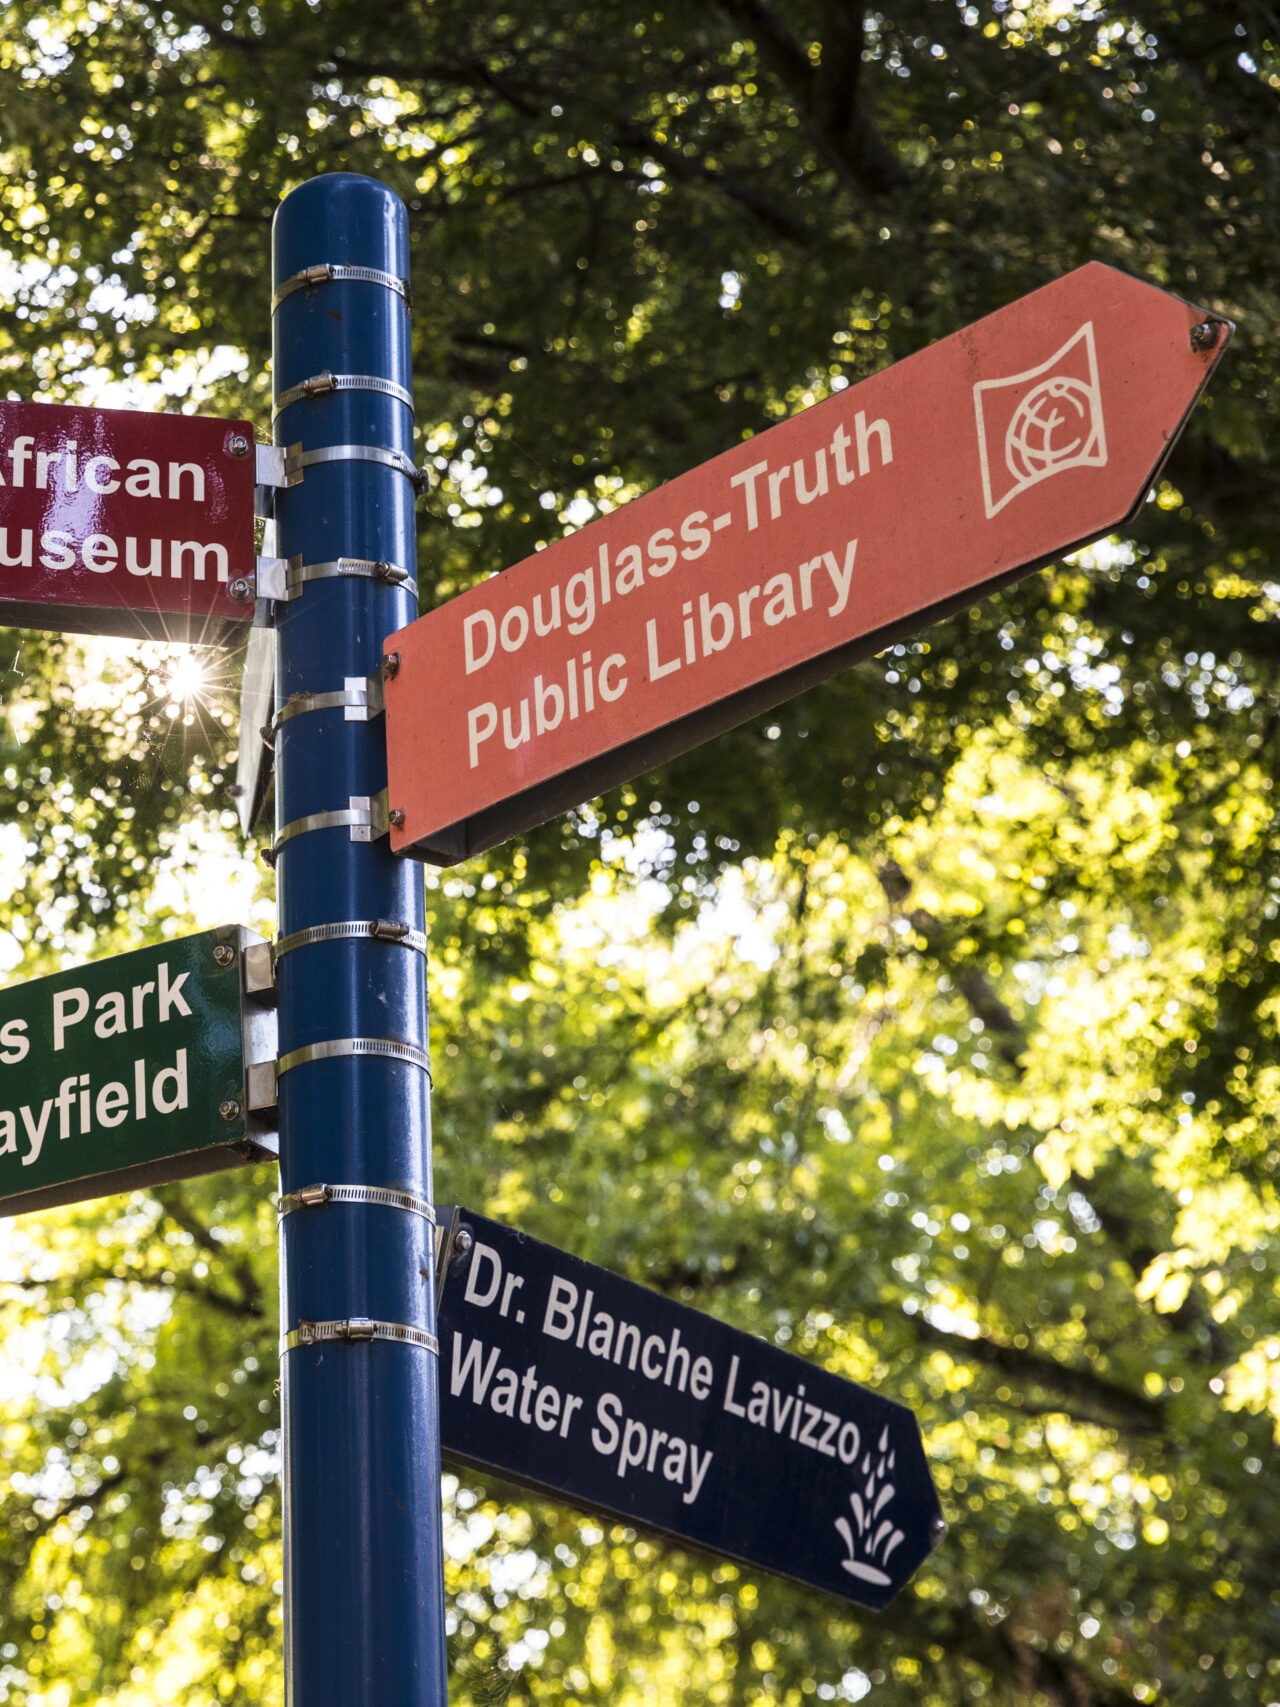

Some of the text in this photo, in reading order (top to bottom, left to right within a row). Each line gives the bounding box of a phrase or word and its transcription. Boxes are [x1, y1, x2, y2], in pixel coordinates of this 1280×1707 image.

[463, 410, 895, 675] Douglass-Truth
[467, 539, 859, 769] Public Library
[52, 961, 193, 1051] Park
[449, 1331, 713, 1505] Water Spray
[464, 1241, 861, 1465] Dr. Blanche Lavizzo
